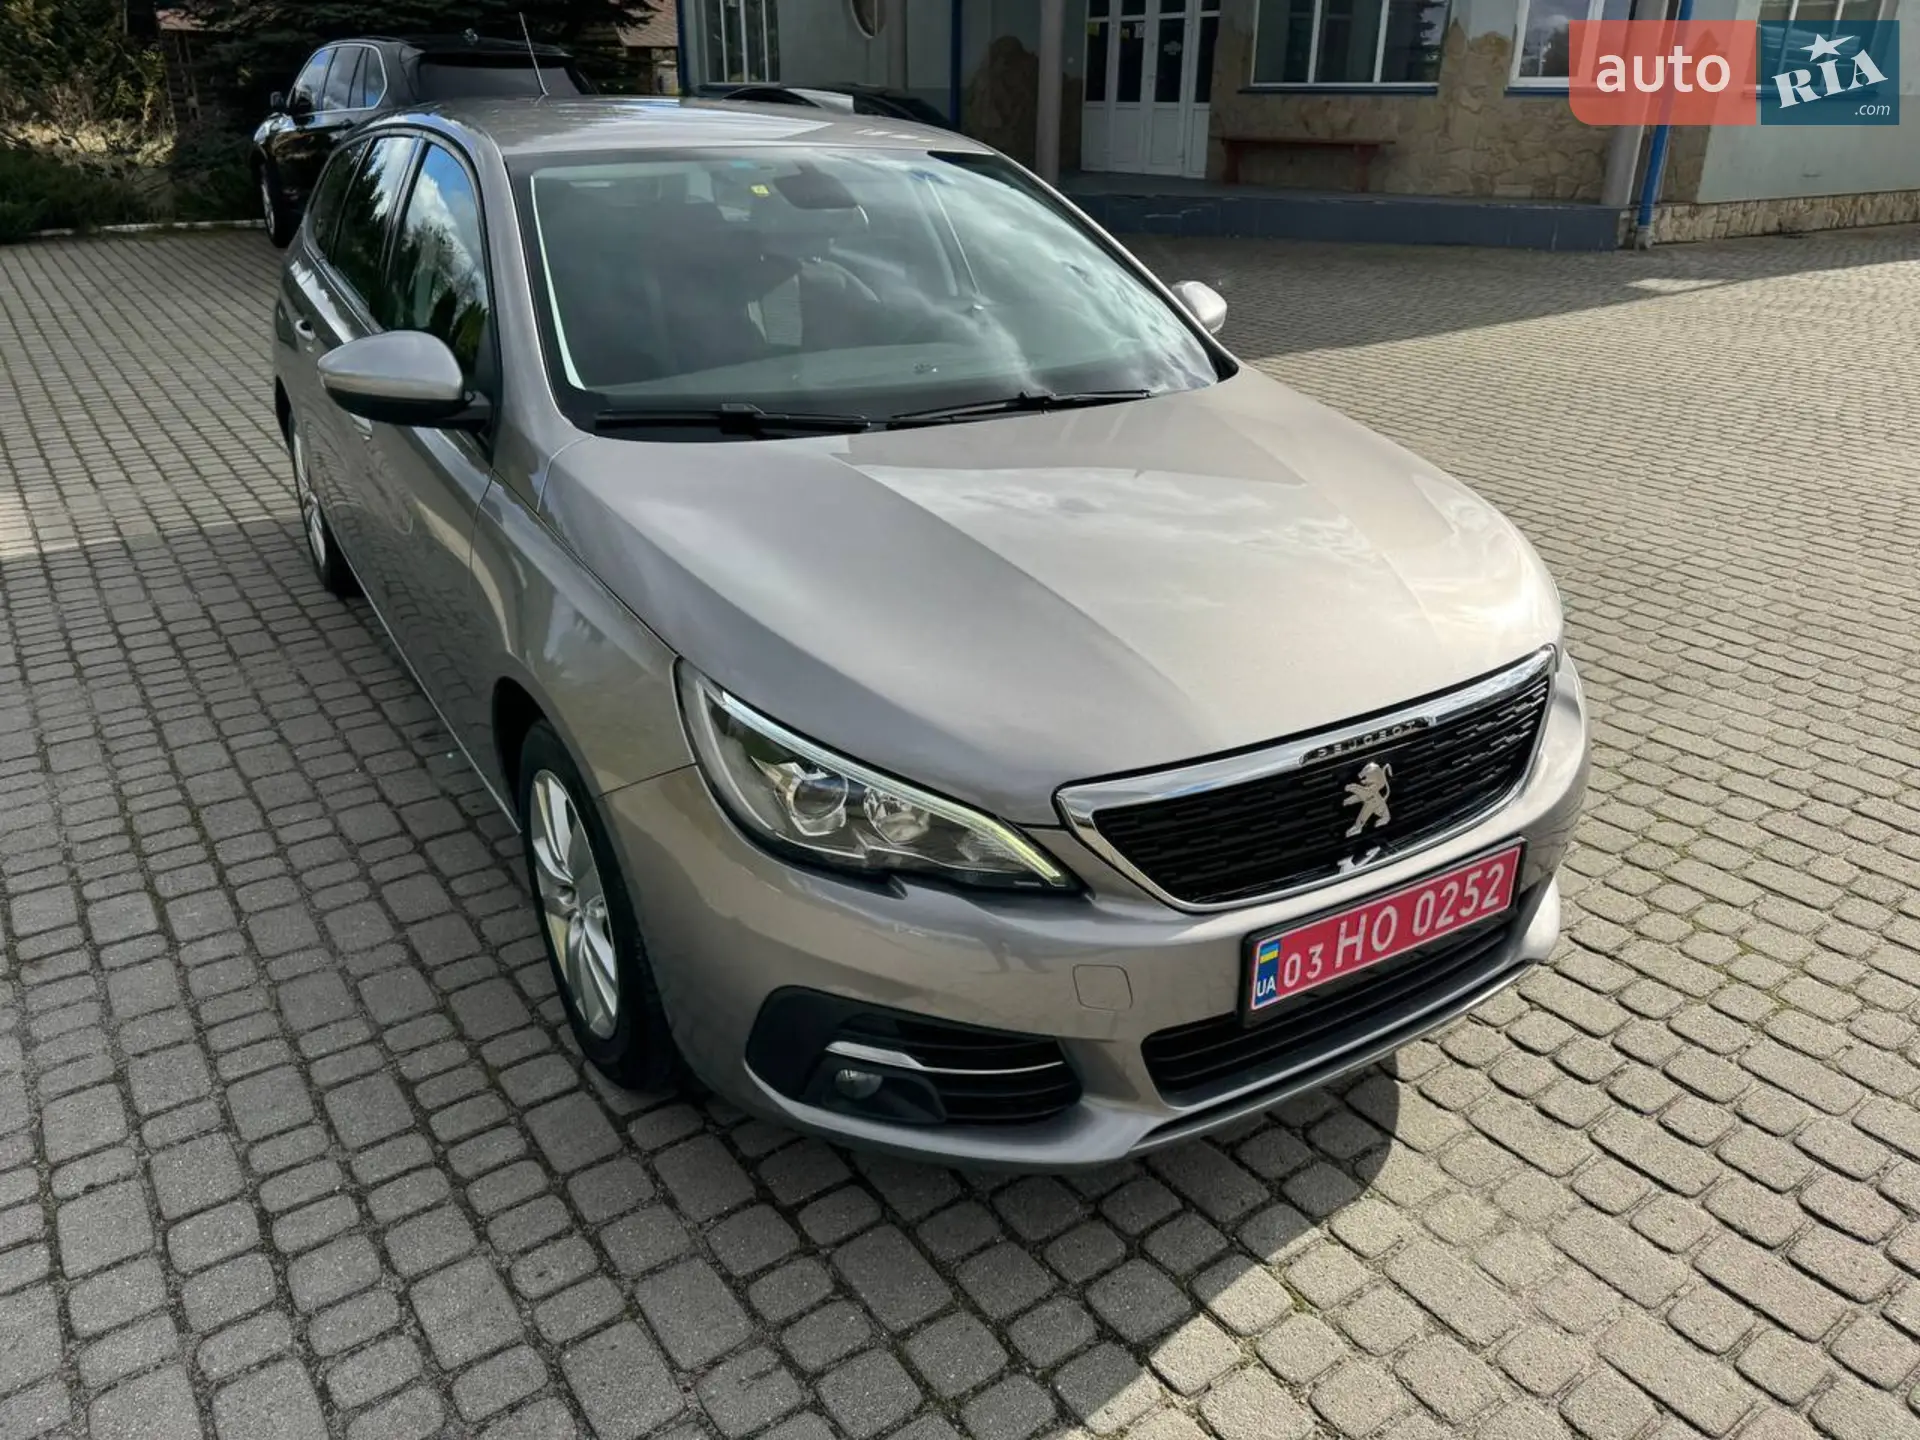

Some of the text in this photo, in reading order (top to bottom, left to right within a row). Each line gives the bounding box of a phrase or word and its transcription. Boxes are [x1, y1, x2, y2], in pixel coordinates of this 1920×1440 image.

[1284, 862, 1505, 988] 03 HO 0252
[1256, 975, 1277, 997] UA
